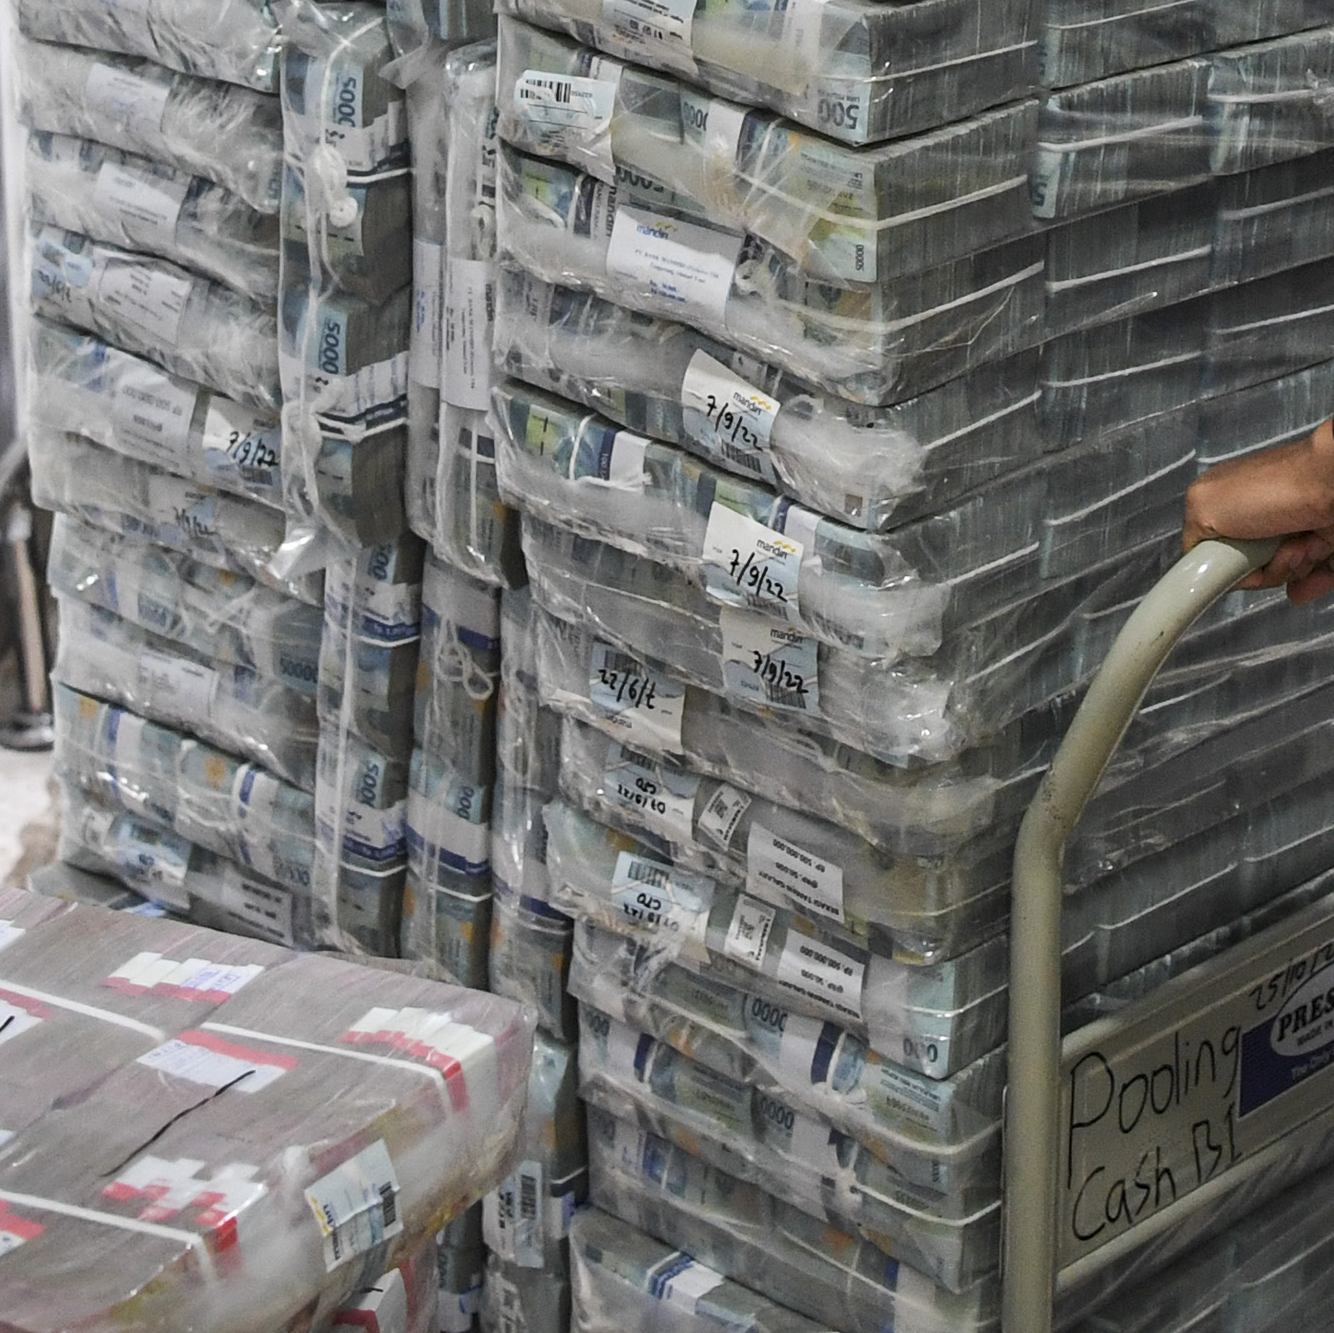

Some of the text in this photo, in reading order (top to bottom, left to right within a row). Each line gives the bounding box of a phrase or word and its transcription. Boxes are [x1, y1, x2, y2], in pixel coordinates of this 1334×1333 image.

[225, 430, 280, 467] 7/9/22
[707, 395, 764, 453] 7/9/22
[730, 549, 788, 603] 7/9/22
[752, 650, 809, 694] 7/9/22
[1296, 1024, 1322, 1048] MADE
[1323, 1019, 1334, 1032] IN
[1067, 1026, 1242, 1190] Pooling
[1072, 1145, 1177, 1242] Cash
